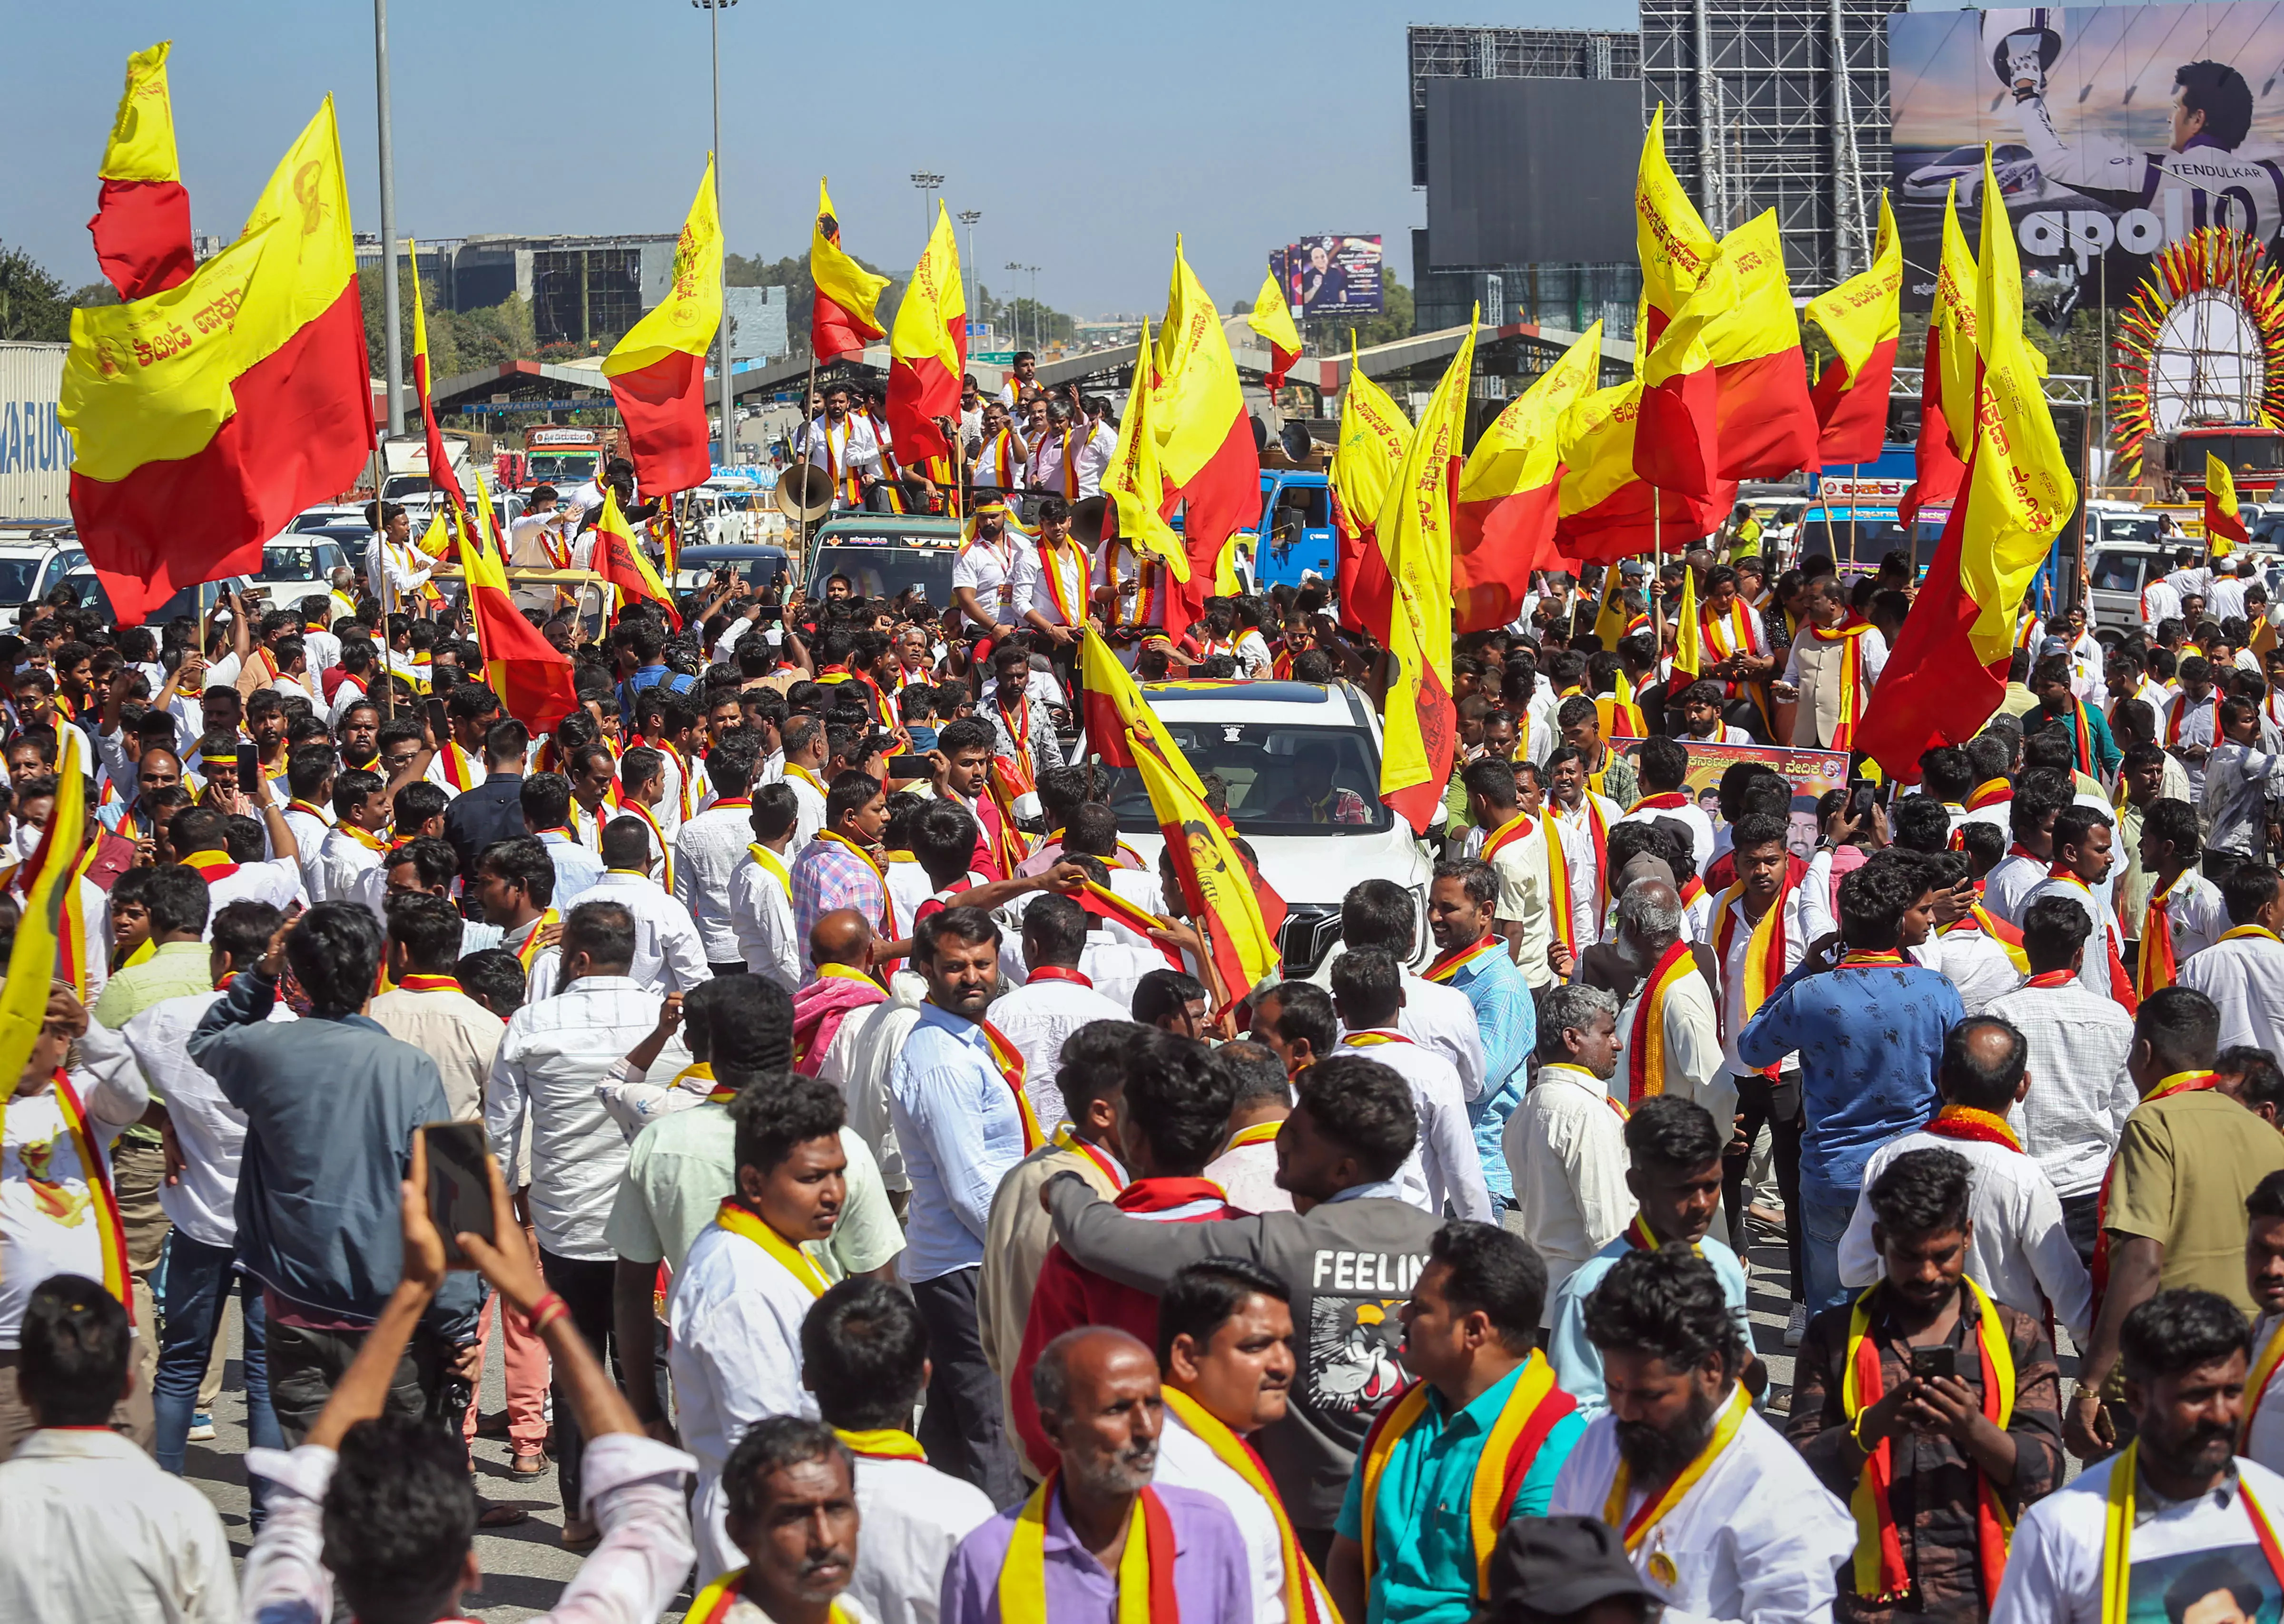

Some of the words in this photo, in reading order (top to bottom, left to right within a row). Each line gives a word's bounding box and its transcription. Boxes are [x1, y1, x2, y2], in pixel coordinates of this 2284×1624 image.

[2171, 164, 2262, 178] TENDULKAR
[485, 403, 548, 411] TOWARDS
[551, 399, 608, 408] AIRPORT
[1979, 387, 2010, 457] ರಕ್ಣಾ
[1388, 436, 1404, 460] ರಕ್ಷ
[1688, 754, 1741, 770] ಕರ್ನಾಟಕ
[1785, 760, 1821, 775] ವೇದಿಕೆ
[1313, 1249, 1431, 1292] FEELIN
